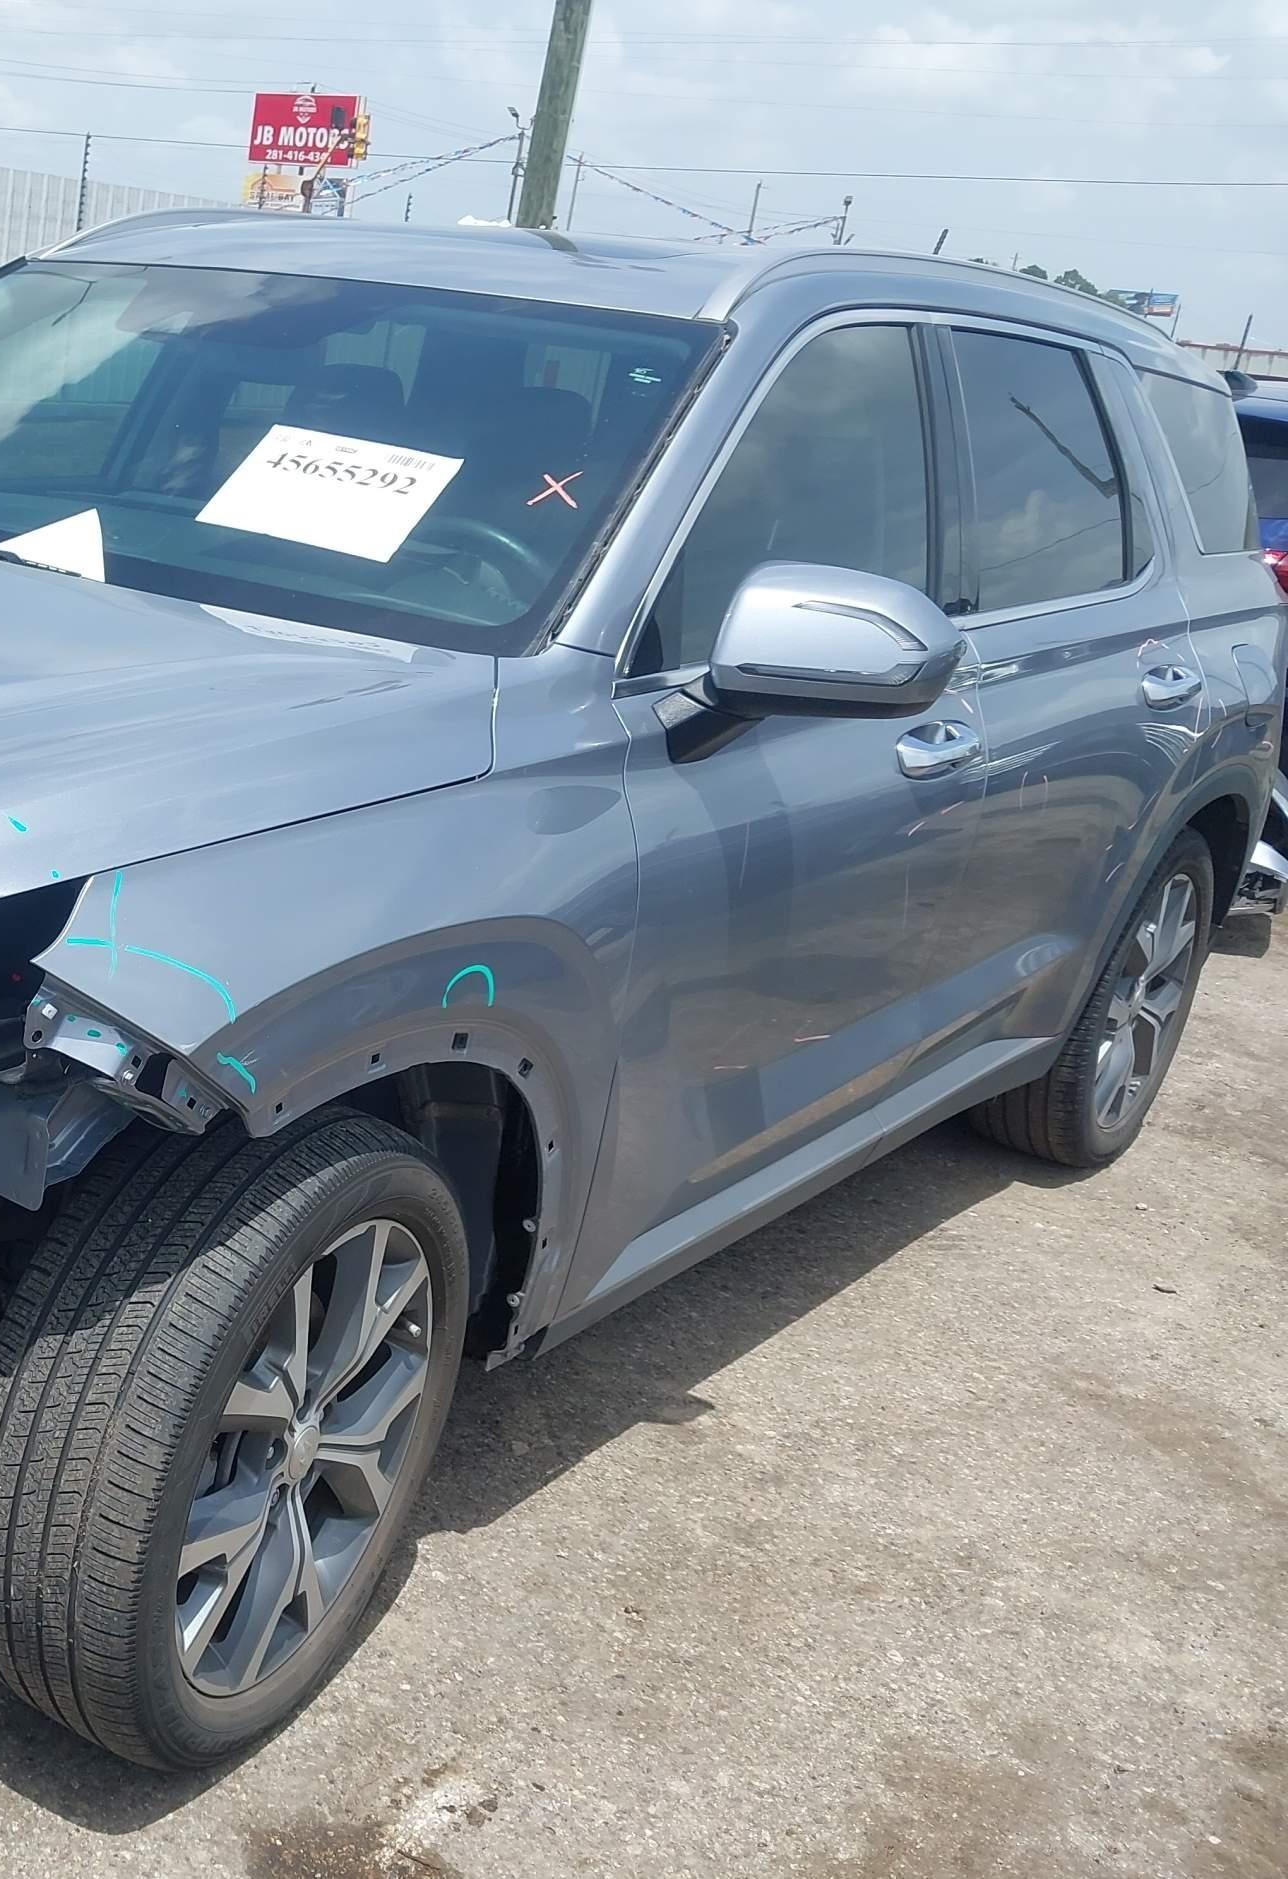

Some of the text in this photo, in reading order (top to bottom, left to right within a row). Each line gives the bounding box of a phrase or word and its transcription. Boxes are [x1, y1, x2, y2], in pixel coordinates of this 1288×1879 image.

[254, 125, 274, 146] JB
[278, 126, 349, 149] MOTORS
[266, 451, 417, 495] 45655292
